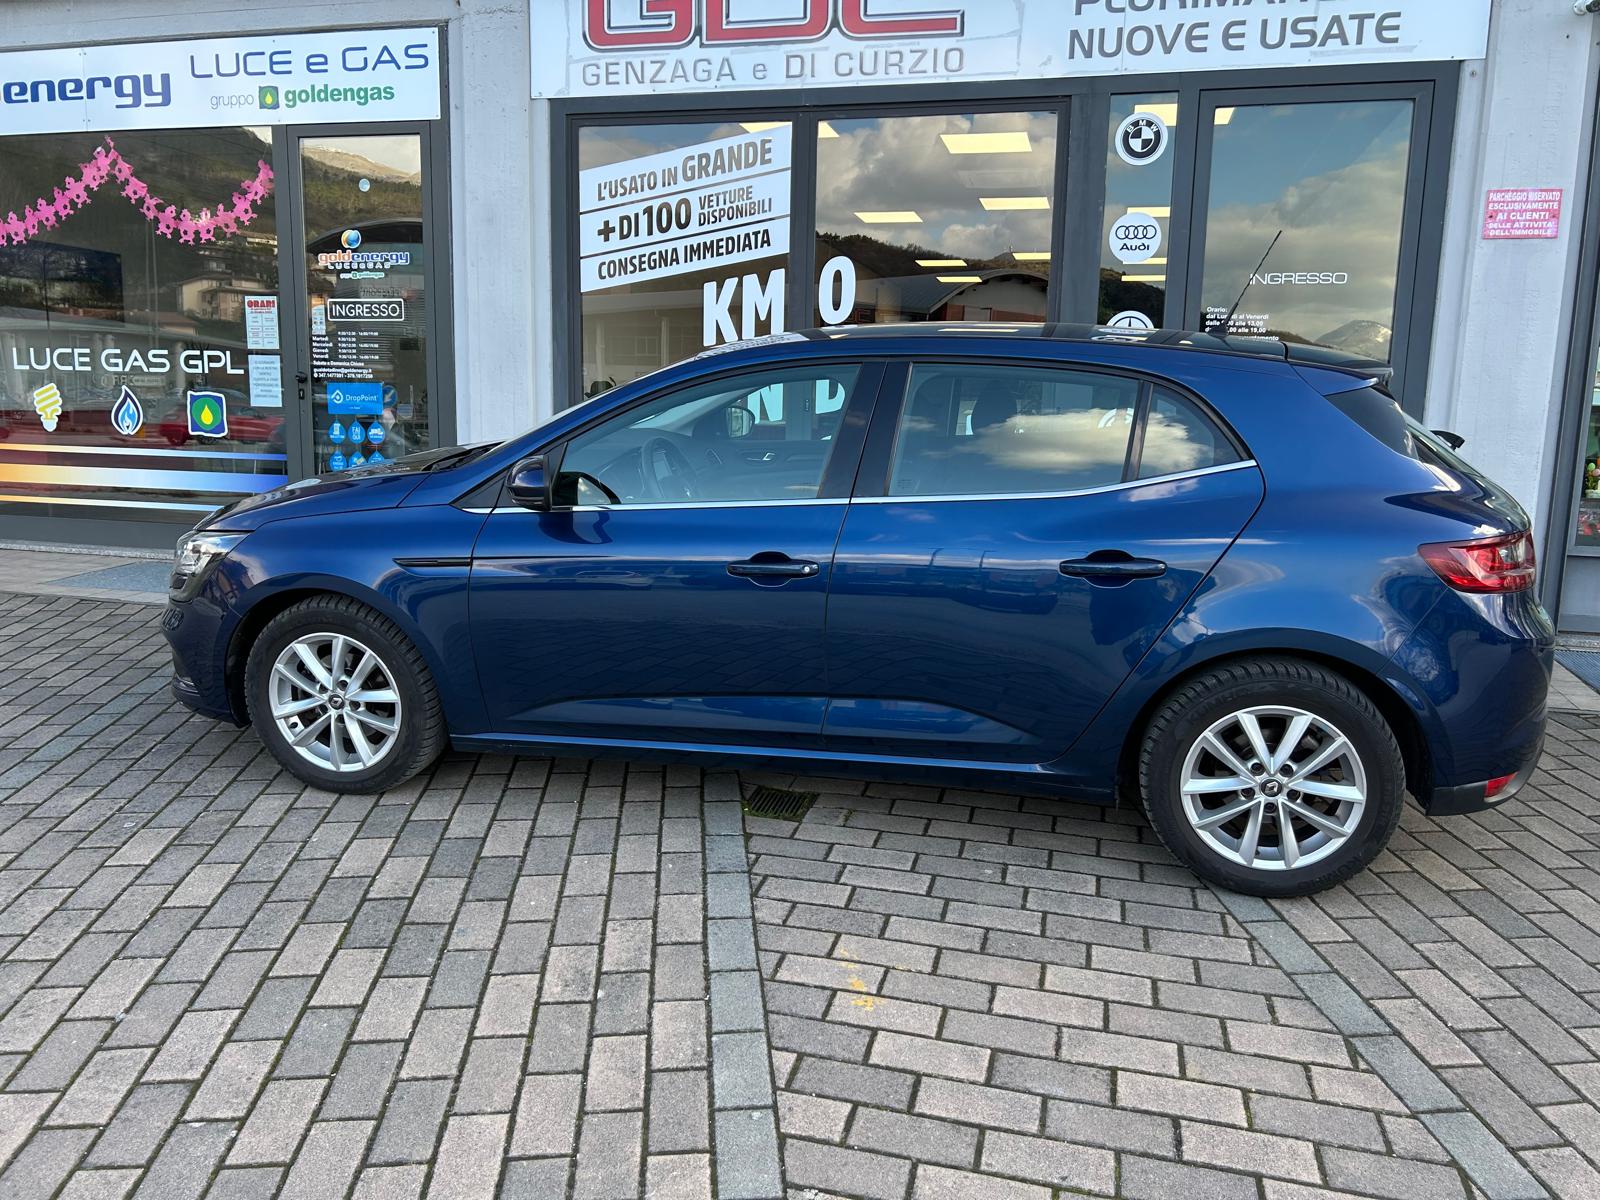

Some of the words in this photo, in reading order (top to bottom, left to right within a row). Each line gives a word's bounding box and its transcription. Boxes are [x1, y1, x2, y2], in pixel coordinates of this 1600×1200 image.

[1068, 21, 1209, 60] NUOVE
[1221, 19, 1247, 52] E
[1259, 11, 1402, 50] USATE
[190, 50, 293, 79] LUCE
[306, 52, 329, 74] e
[342, 43, 430, 72] GAS
[582, 56, 737, 86] GENZAGA
[752, 62, 768, 80] e
[785, 54, 816, 79] DI
[834, 47, 965, 77] CURZIO
[210, 91, 254, 111] gruppo
[284, 82, 395, 109] goldengas
[1126, 119, 1159, 133] BMW
[597, 171, 657, 202] L'USATO
[661, 166, 677, 187] IN
[682, 138, 773, 182] GRANDE
[699, 185, 753, 210] VETTURE
[1488, 202, 1559, 210] ESCLUSIVAMENTE
[642, 197, 692, 236] 100
[699, 197, 772, 227] DISPONIBILI
[1497, 212, 1507, 220] AI
[1510, 211, 1549, 220] CLIENTI
[319, 250, 409, 266] goldenergy
[598, 247, 680, 280] CONSEGNA
[684, 228, 771, 264] IMMEDIATA
[1119, 242, 1150, 251] Audi
[1249, 272, 1348, 285] INGRESSO
[332, 304, 400, 317] INGRESSO
[703, 268, 786, 347] KM
[12, 347, 92, 372] LUCE
[100, 348, 171, 373] GAS
[179, 350, 245, 375] GPL
[345, 393, 378, 403] DropPoint
